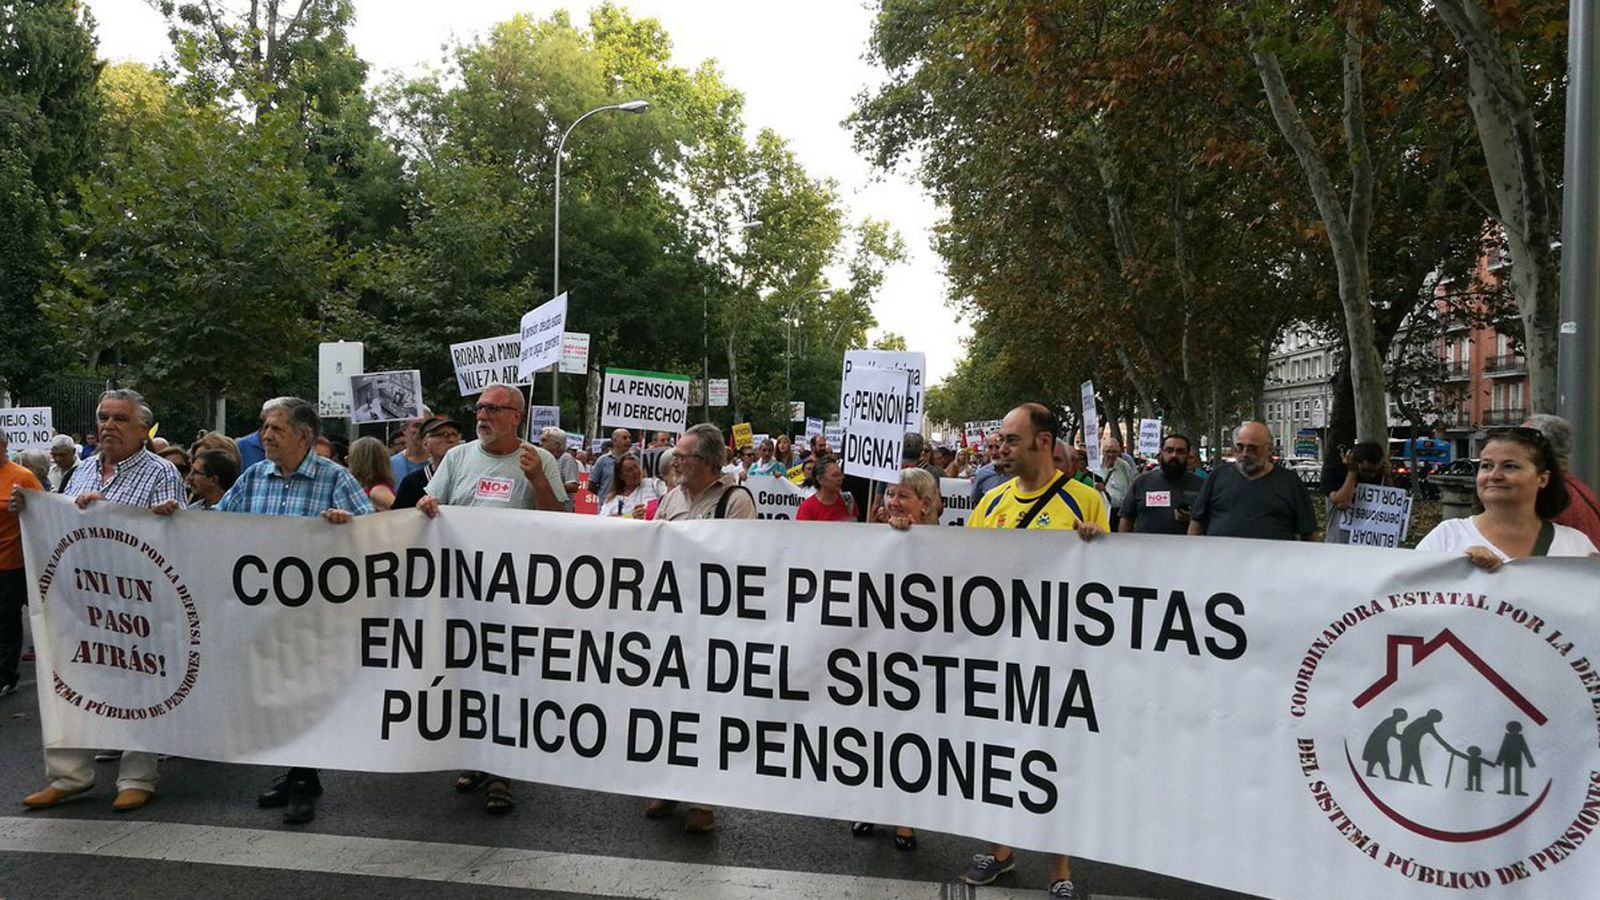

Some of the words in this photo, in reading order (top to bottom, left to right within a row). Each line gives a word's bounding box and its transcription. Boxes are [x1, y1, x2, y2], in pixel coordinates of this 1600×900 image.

[453, 345, 487, 368] ROBAR
[488, 345, 497, 362] al
[497, 341, 521, 361] MAYO
[610, 378, 625, 394] LA
[629, 381, 686, 404] PENSIÓN,
[849, 386, 904, 426] ¡PENSIÓN
[607, 401, 621, 417] MI
[624, 403, 685, 424] DERECHO!
[847, 433, 902, 471] DIGNA!
[1356, 508, 1401, 526] pensiones
[1382, 491, 1403, 507] POR
[73, 528, 88, 541] DE
[88, 527, 139, 548] MADRID
[140, 542, 166, 568] POR
[164, 565, 180, 585] LA
[176, 584, 201, 647] DEFENSA
[74, 568, 111, 595] ¡NI
[115, 575, 153, 603] UN
[232, 547, 683, 613] COORDINADORA
[700, 562, 767, 620] DE
[786, 567, 1248, 660] PENSIONISTAS
[87, 605, 150, 638] PASO
[71, 640, 167, 677] ATRÁS!
[1290, 599, 1385, 718] COORDINADORA
[1387, 591, 1490, 611] ESTATAL
[1496, 600, 1546, 634] POR
[1545, 630, 1575, 657] LA
[84, 699, 148, 720] PÚBLICO
[149, 702, 167, 719] DE
[166, 650, 201, 710] PENSIONES
[361, 617, 423, 669] EN
[445, 618, 690, 689] DEFENSA
[706, 638, 810, 701] DEL
[826, 647, 1100, 733] SISTEMA
[381, 675, 607, 758] PÚBLICO
[627, 707, 700, 767] DE
[719, 716, 1059, 814] PENSIONES
[1297, 738, 1318, 777] DEL
[1309, 779, 1381, 859] SISTEMA
[1384, 851, 1491, 889] PÚBLICO
[1495, 861, 1531, 885] DE
